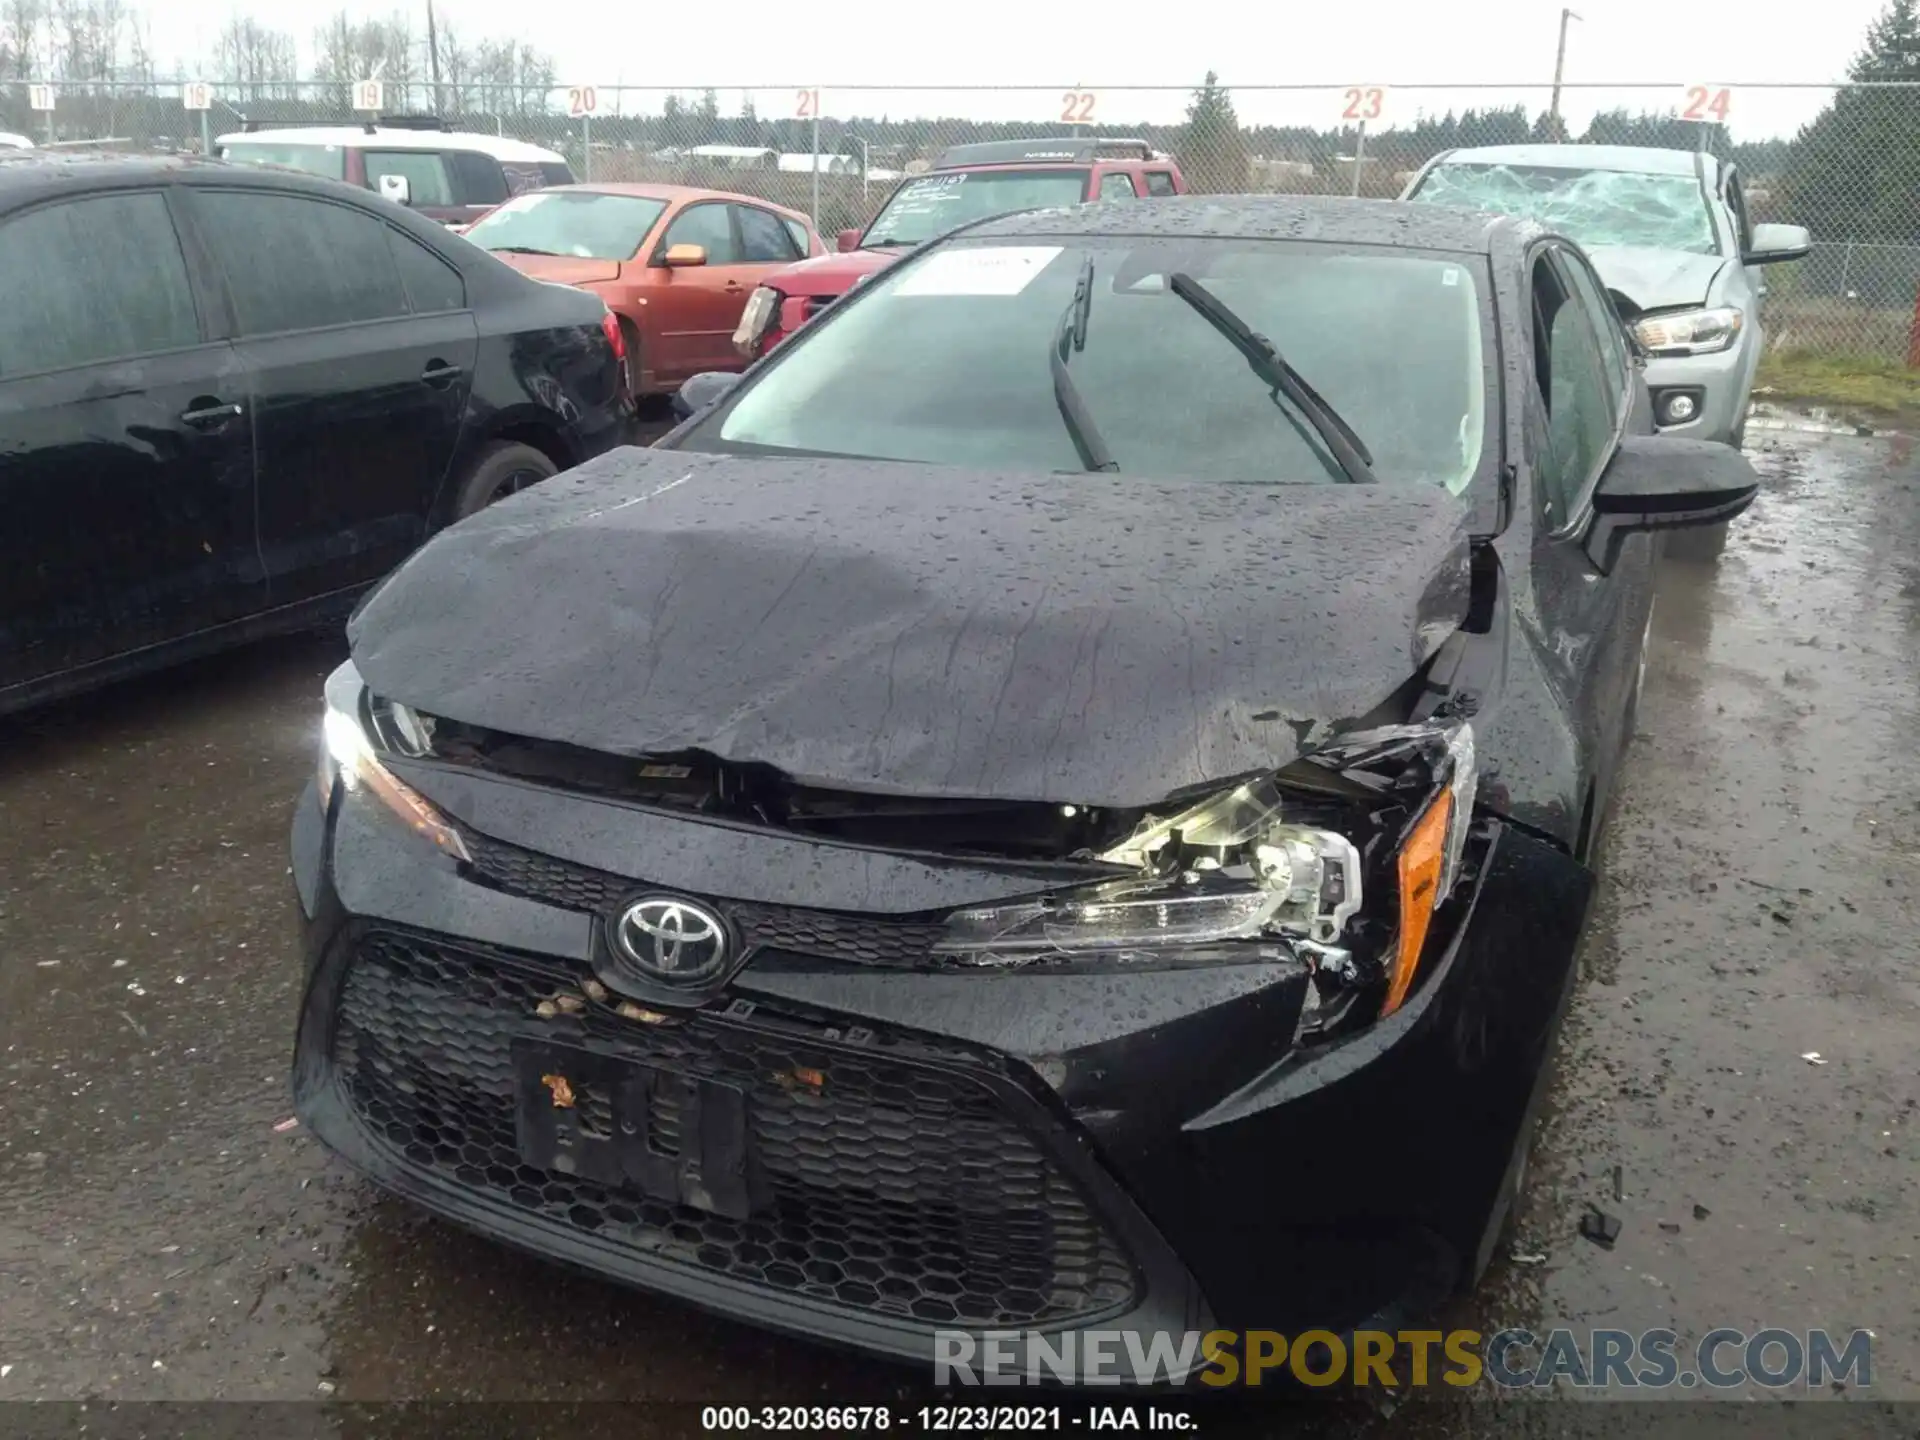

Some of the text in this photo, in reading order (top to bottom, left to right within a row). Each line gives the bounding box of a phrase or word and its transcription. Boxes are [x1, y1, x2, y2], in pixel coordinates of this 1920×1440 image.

[189, 84, 205, 106] 18
[359, 84, 378, 106] 19
[570, 87, 596, 113] 20
[796, 90, 820, 116] 21
[1061, 93, 1096, 122] 22
[1342, 88, 1384, 119] 23
[1683, 86, 1731, 120] 24
